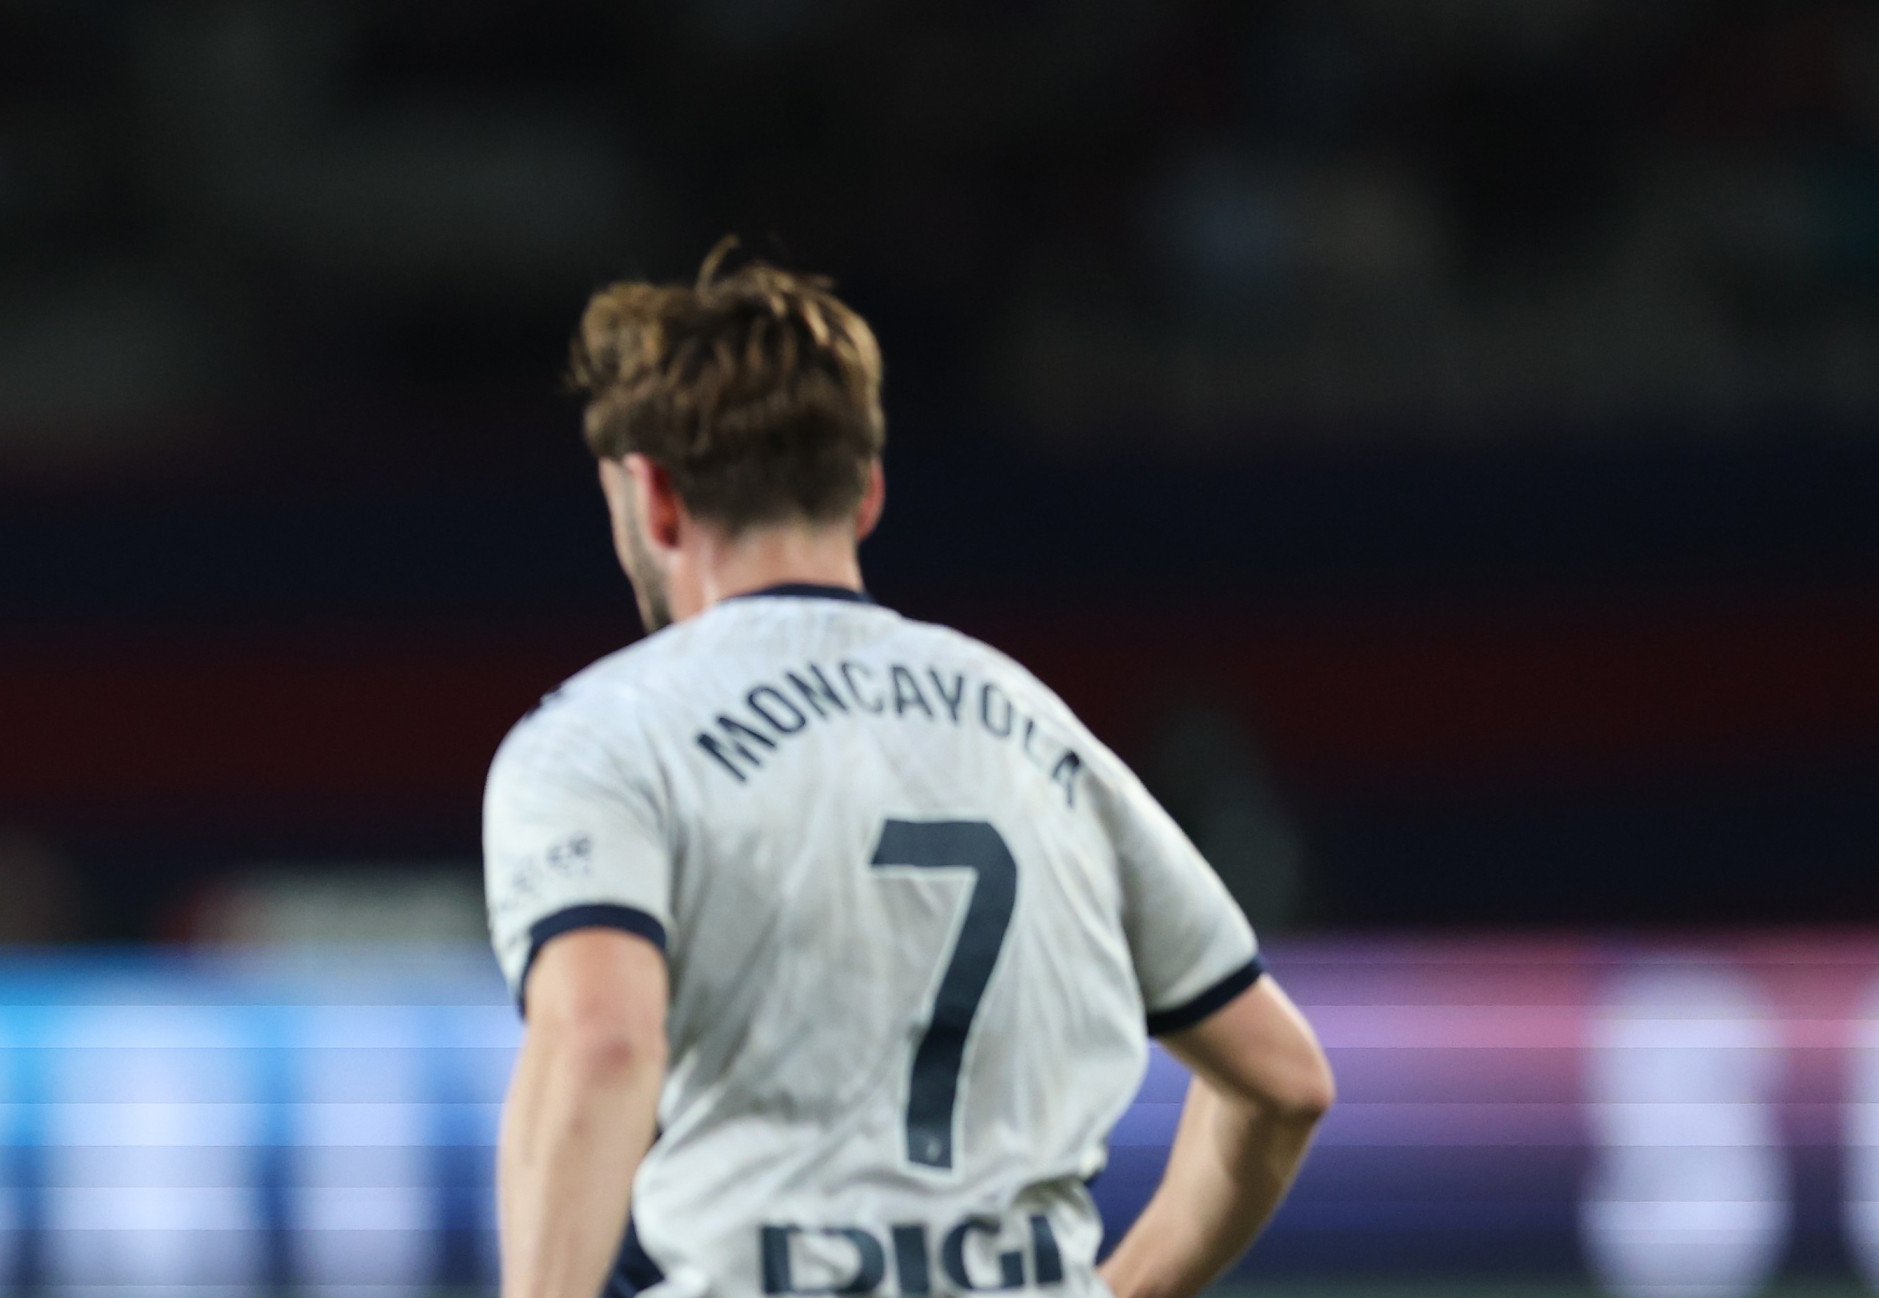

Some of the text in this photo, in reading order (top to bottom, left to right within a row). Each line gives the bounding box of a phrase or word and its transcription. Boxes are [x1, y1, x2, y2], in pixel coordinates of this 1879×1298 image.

[696, 662, 1081, 807] MONCAYOLA
[870, 819, 1017, 1169] 7
[761, 1213, 1064, 1296] DIGI
